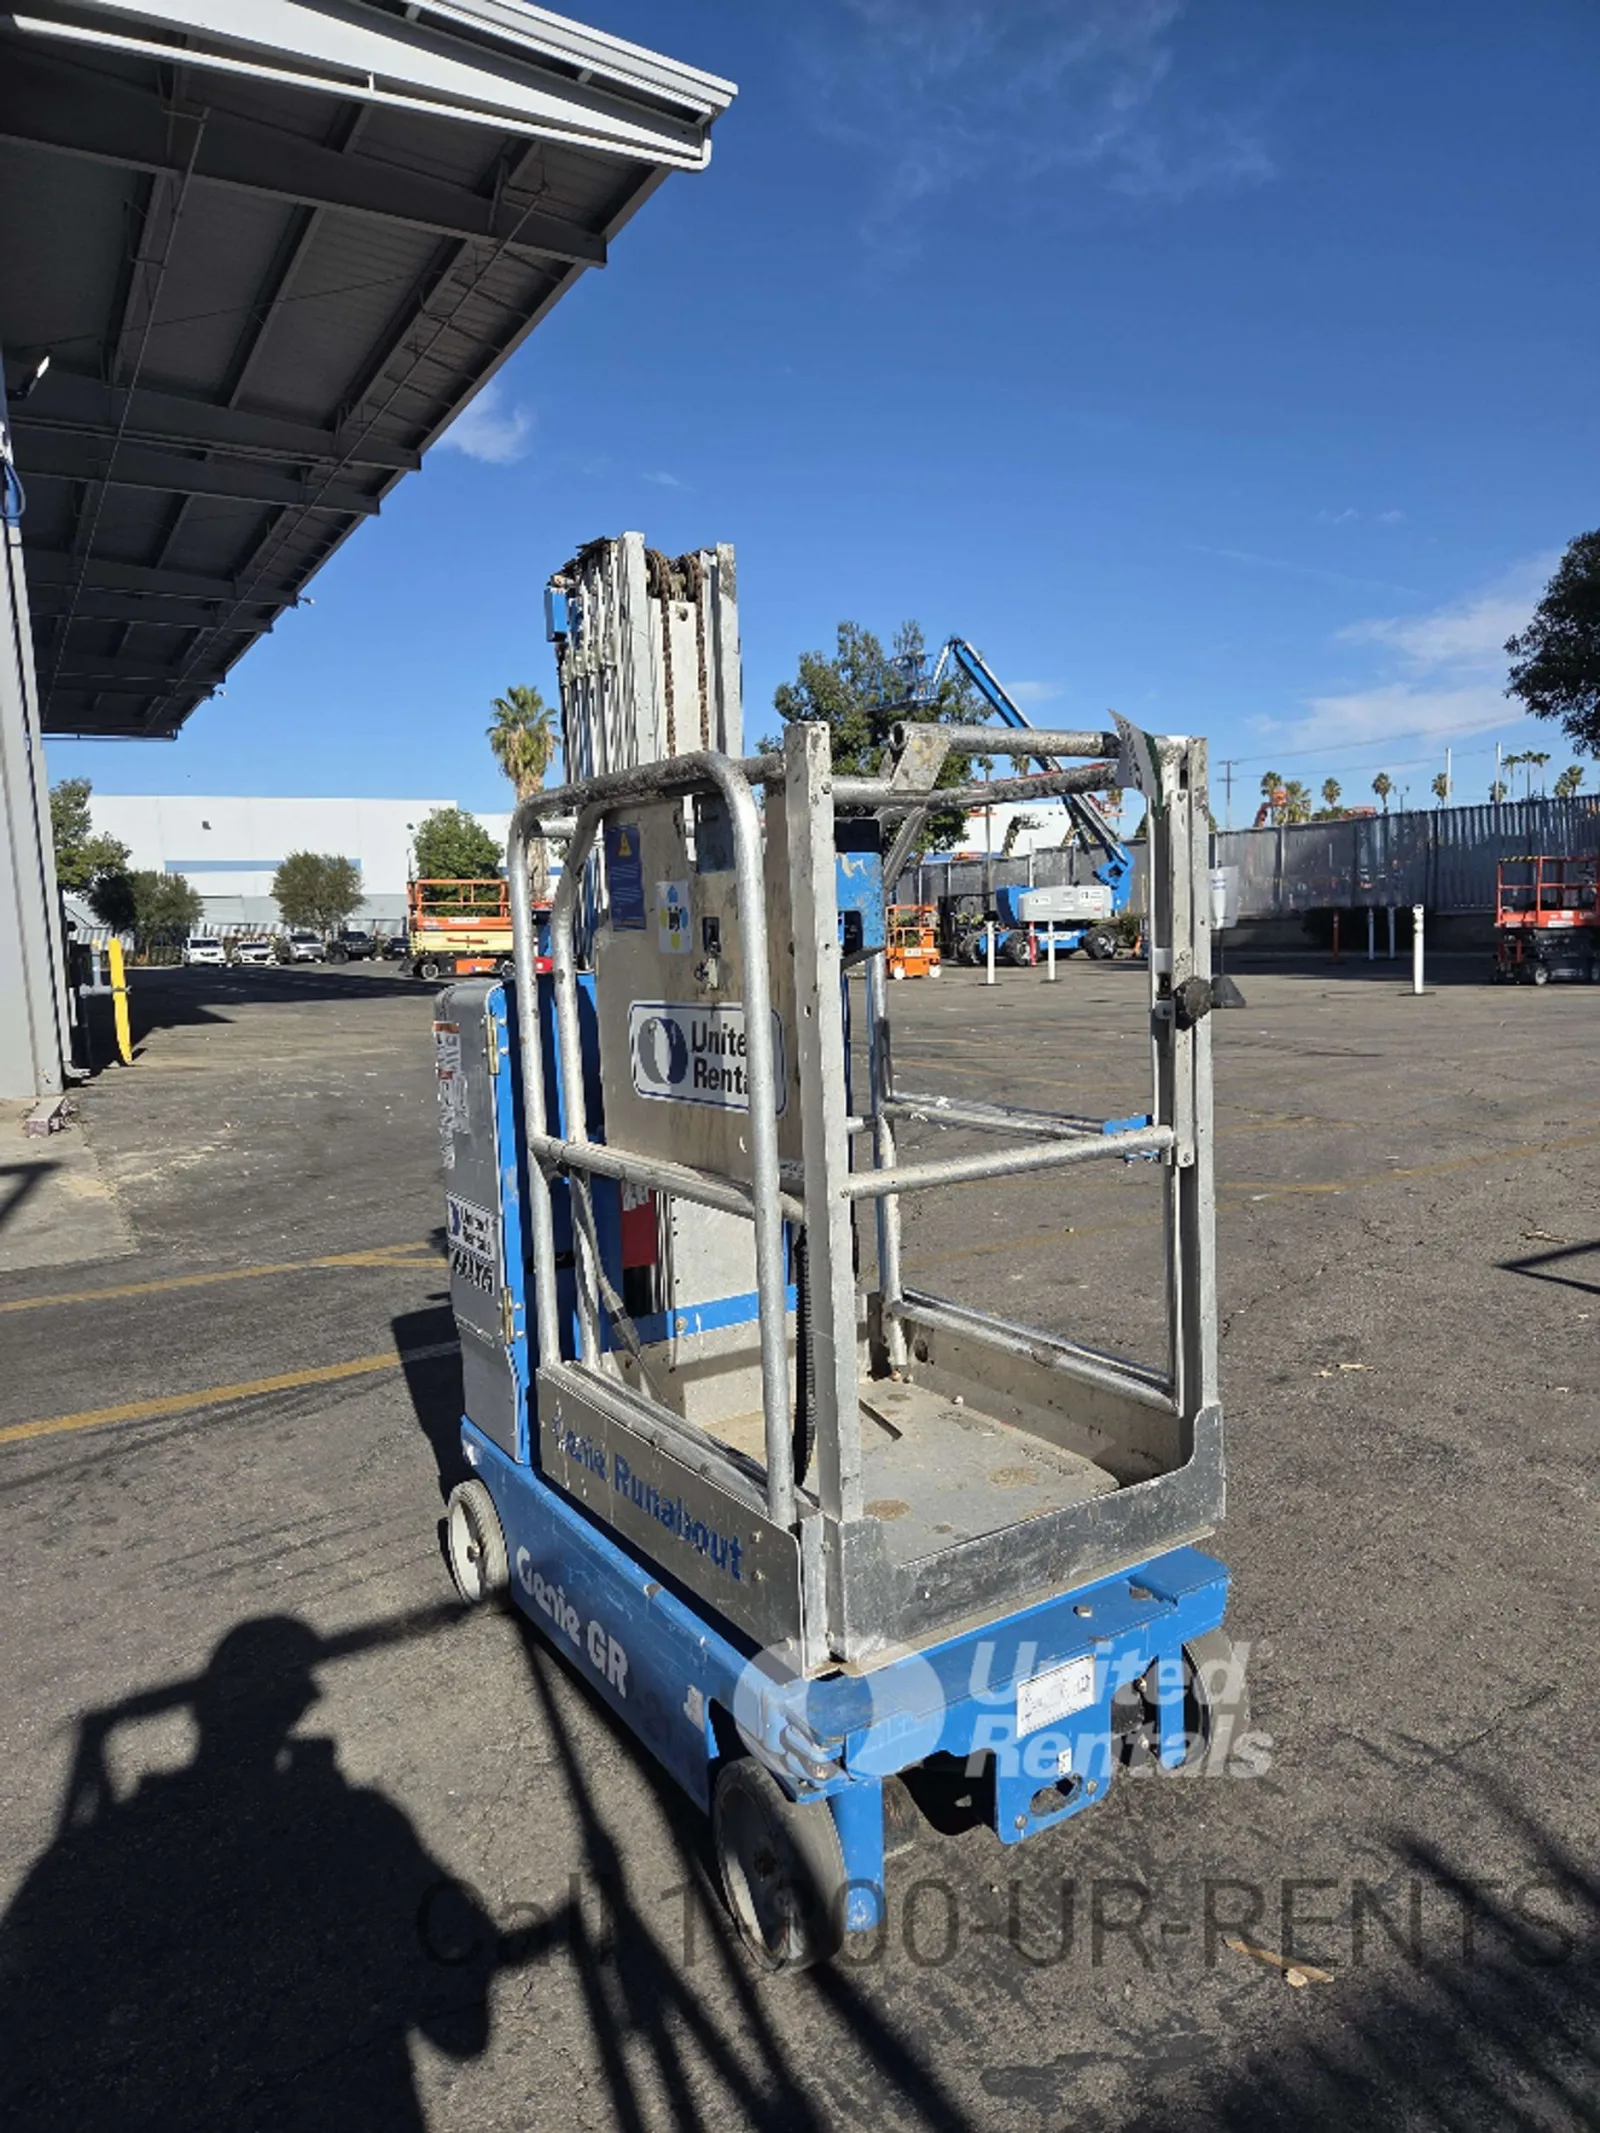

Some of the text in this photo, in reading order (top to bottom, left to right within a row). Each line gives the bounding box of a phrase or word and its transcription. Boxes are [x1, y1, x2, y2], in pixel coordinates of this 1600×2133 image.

[690, 1020, 748, 1058] Unite
[613, 1454, 745, 1581] Runabout
[516, 1545, 628, 1699] Genie GR
